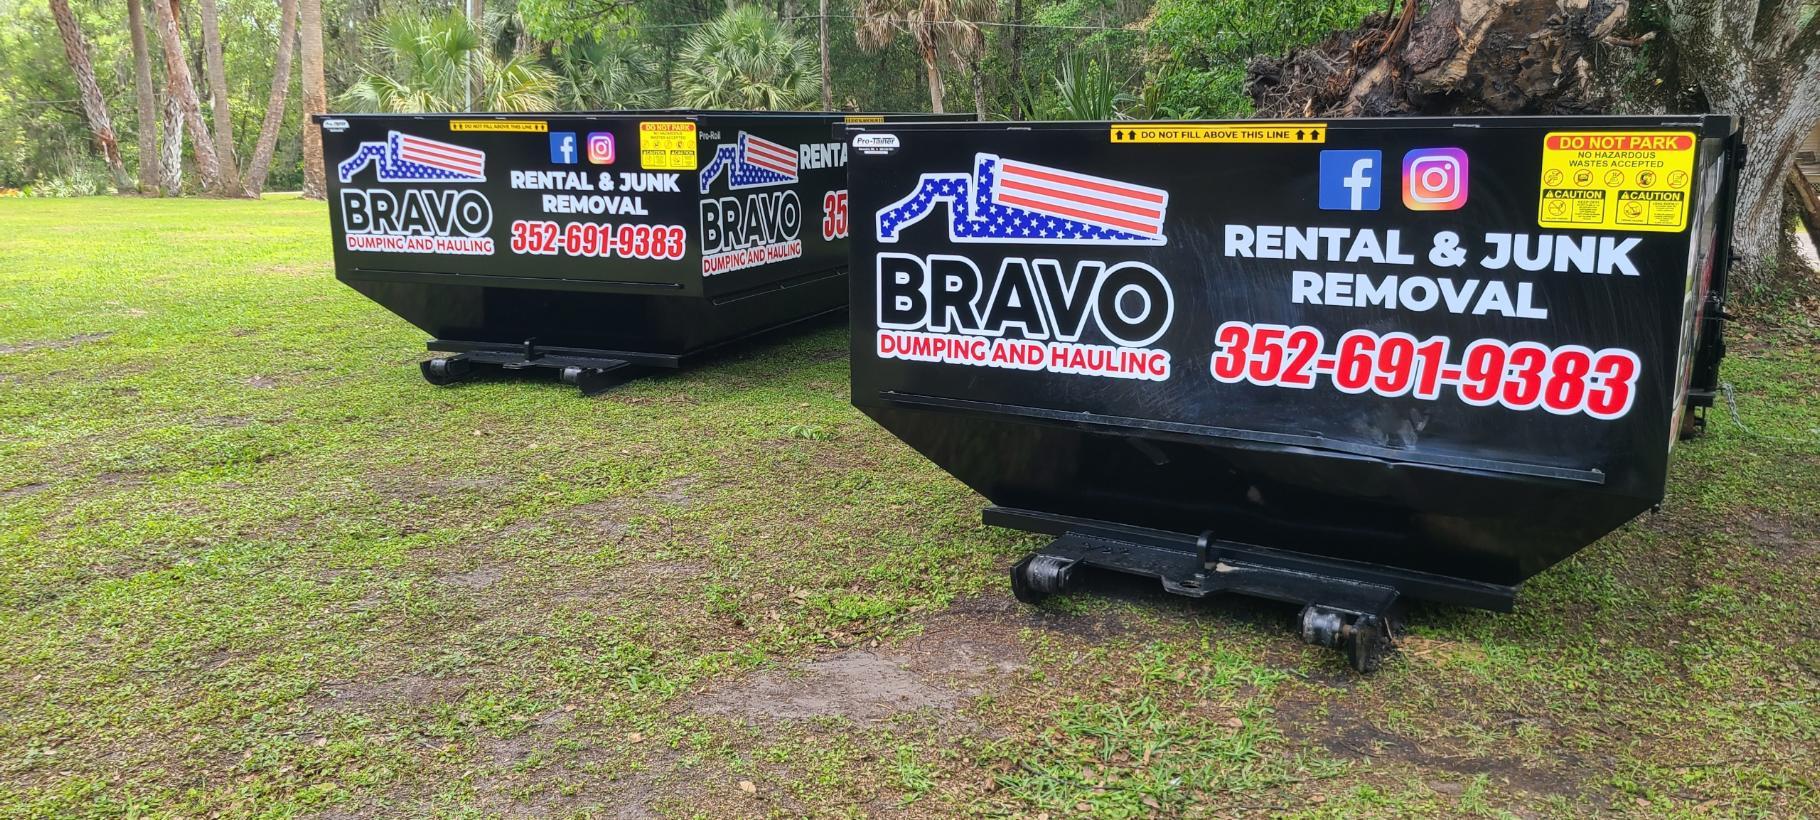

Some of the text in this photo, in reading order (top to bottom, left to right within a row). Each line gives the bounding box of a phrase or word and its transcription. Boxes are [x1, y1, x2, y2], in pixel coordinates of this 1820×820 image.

[698, 130, 721, 140] Pro-Roll
[1141, 131, 1290, 139] DO NOT FILL ABOVE THIS LINE
[1559, 136, 1680, 150] DO NOT PARK
[1569, 160, 1664, 168] WASTES ACCEPTED
[1578, 151, 1656, 159] NO HAZARDOUS
[510, 170, 681, 192] RENTAL & JUNK
[542, 194, 649, 216] REMOVAL
[1554, 190, 1602, 199] CAUTION
[1630, 191, 1681, 201] CAUTION
[340, 189, 493, 237] BRAVO
[700, 190, 801, 255] BRAVO
[349, 236, 492, 252] DUMPING AND HAULING
[512, 221, 685, 259] 352-691-9383
[1224, 224, 1642, 276] RENTAL & JUNK
[703, 242, 801, 274] DUMPING AND HAULING
[877, 252, 1174, 347] BRAVO
[1291, 270, 1548, 319] REMOVAL
[880, 334, 1166, 376] DUMPING AND HAULING
[1213, 323, 1638, 417] 352-691-9383
